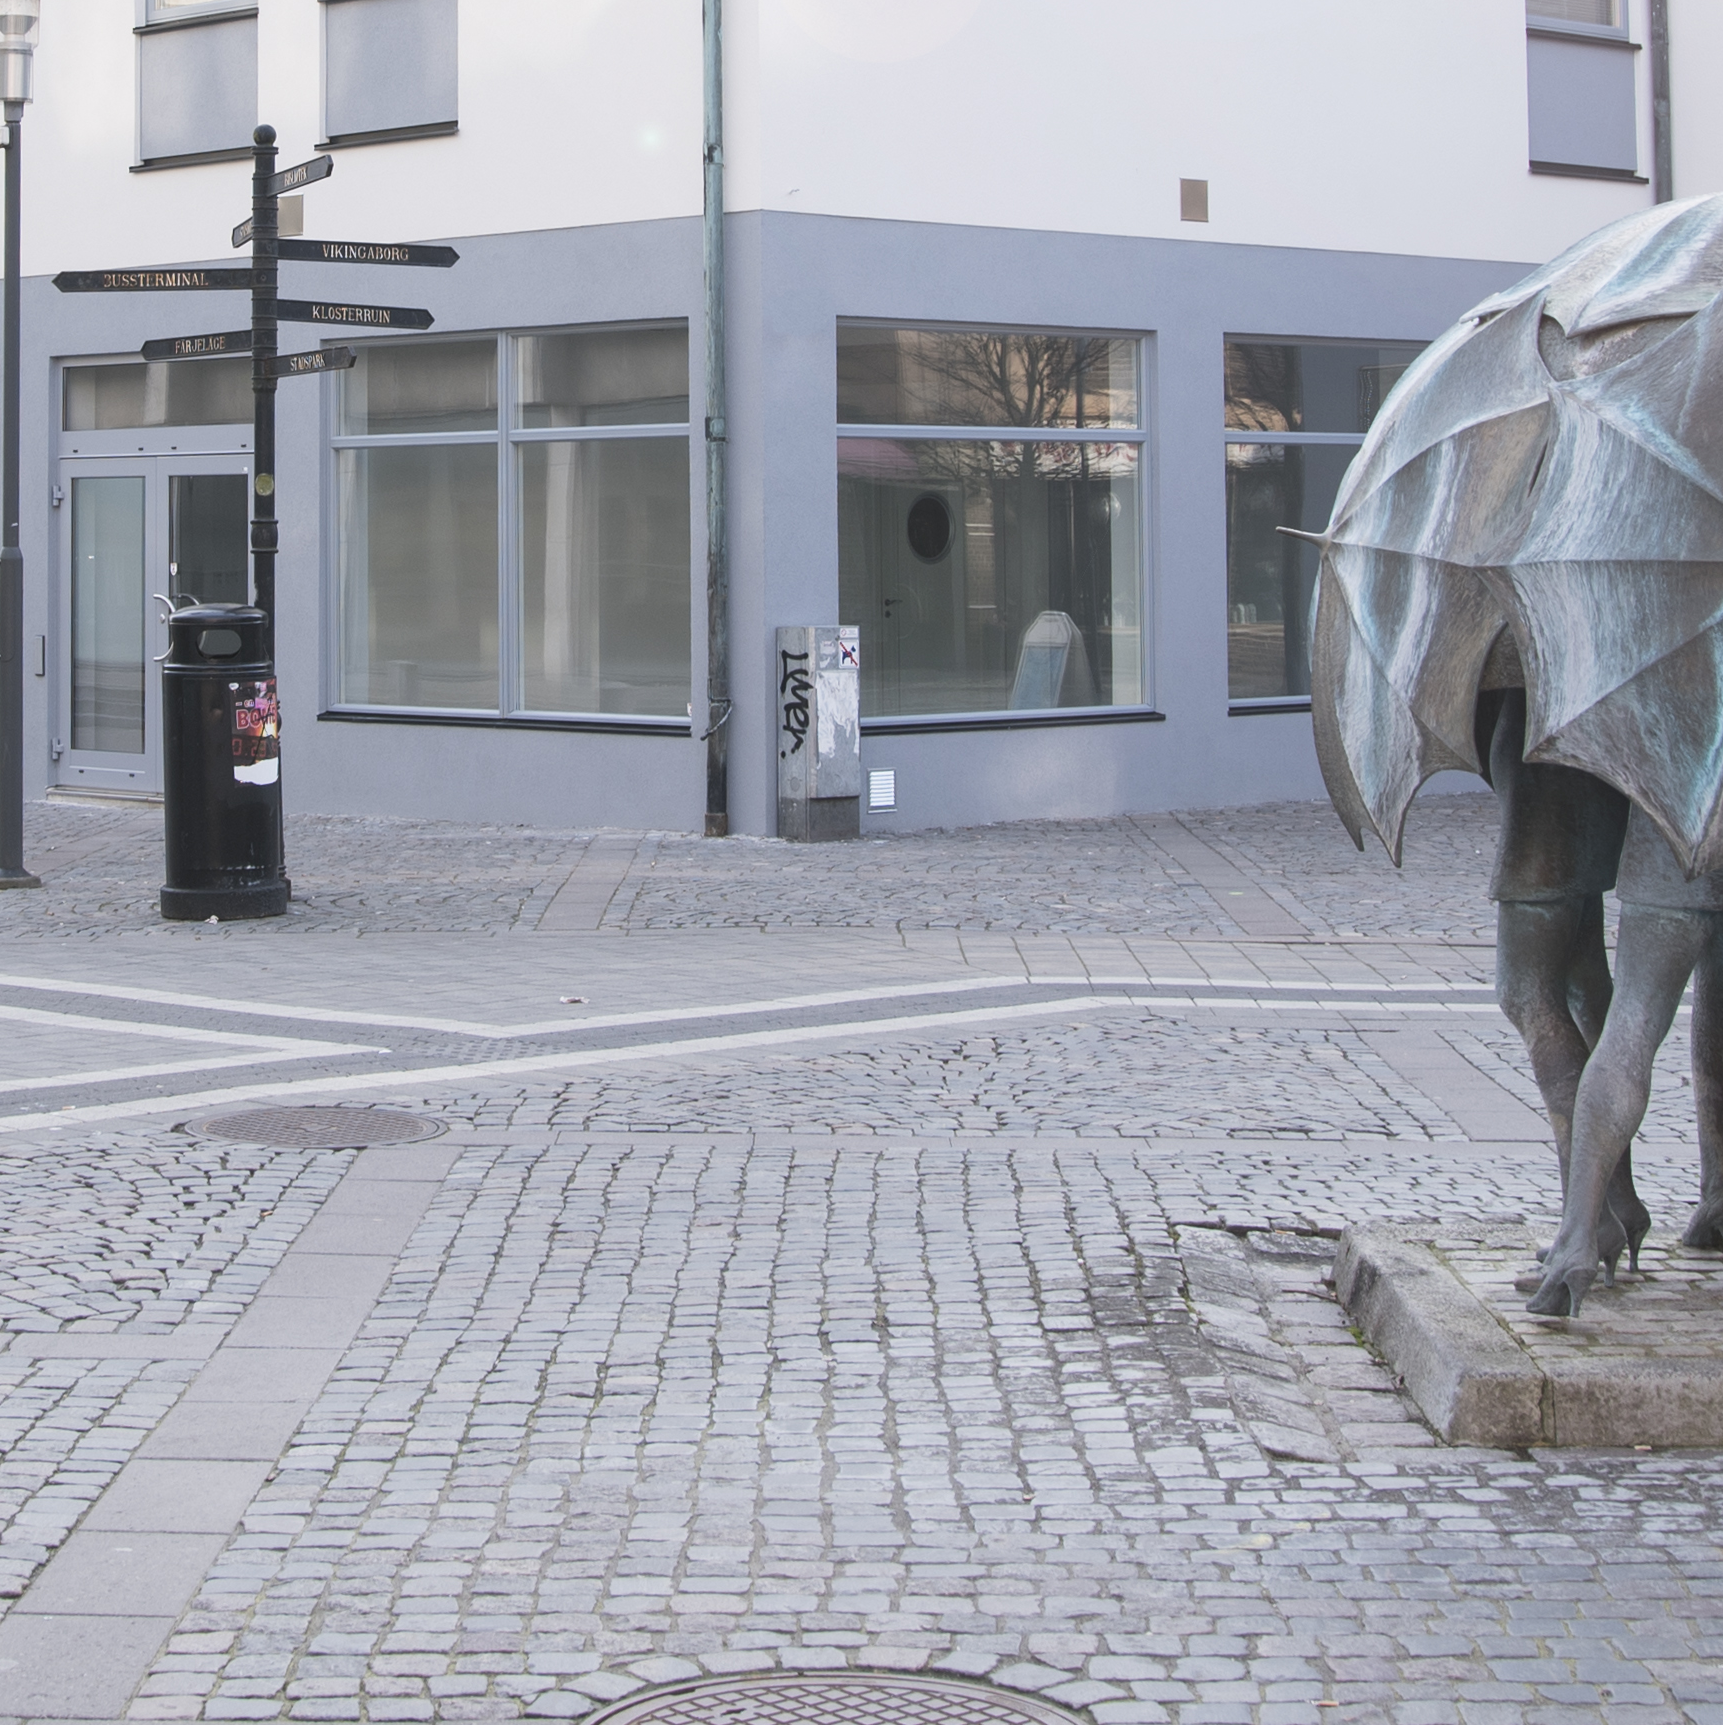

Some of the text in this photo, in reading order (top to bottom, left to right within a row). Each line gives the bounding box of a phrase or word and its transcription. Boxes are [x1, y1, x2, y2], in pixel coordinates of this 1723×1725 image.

[322, 244, 409, 261] VIKINGABORG
[104, 272, 209, 288] BUSSTERMINAL
[312, 305, 391, 324] KLOSTERRUIN
